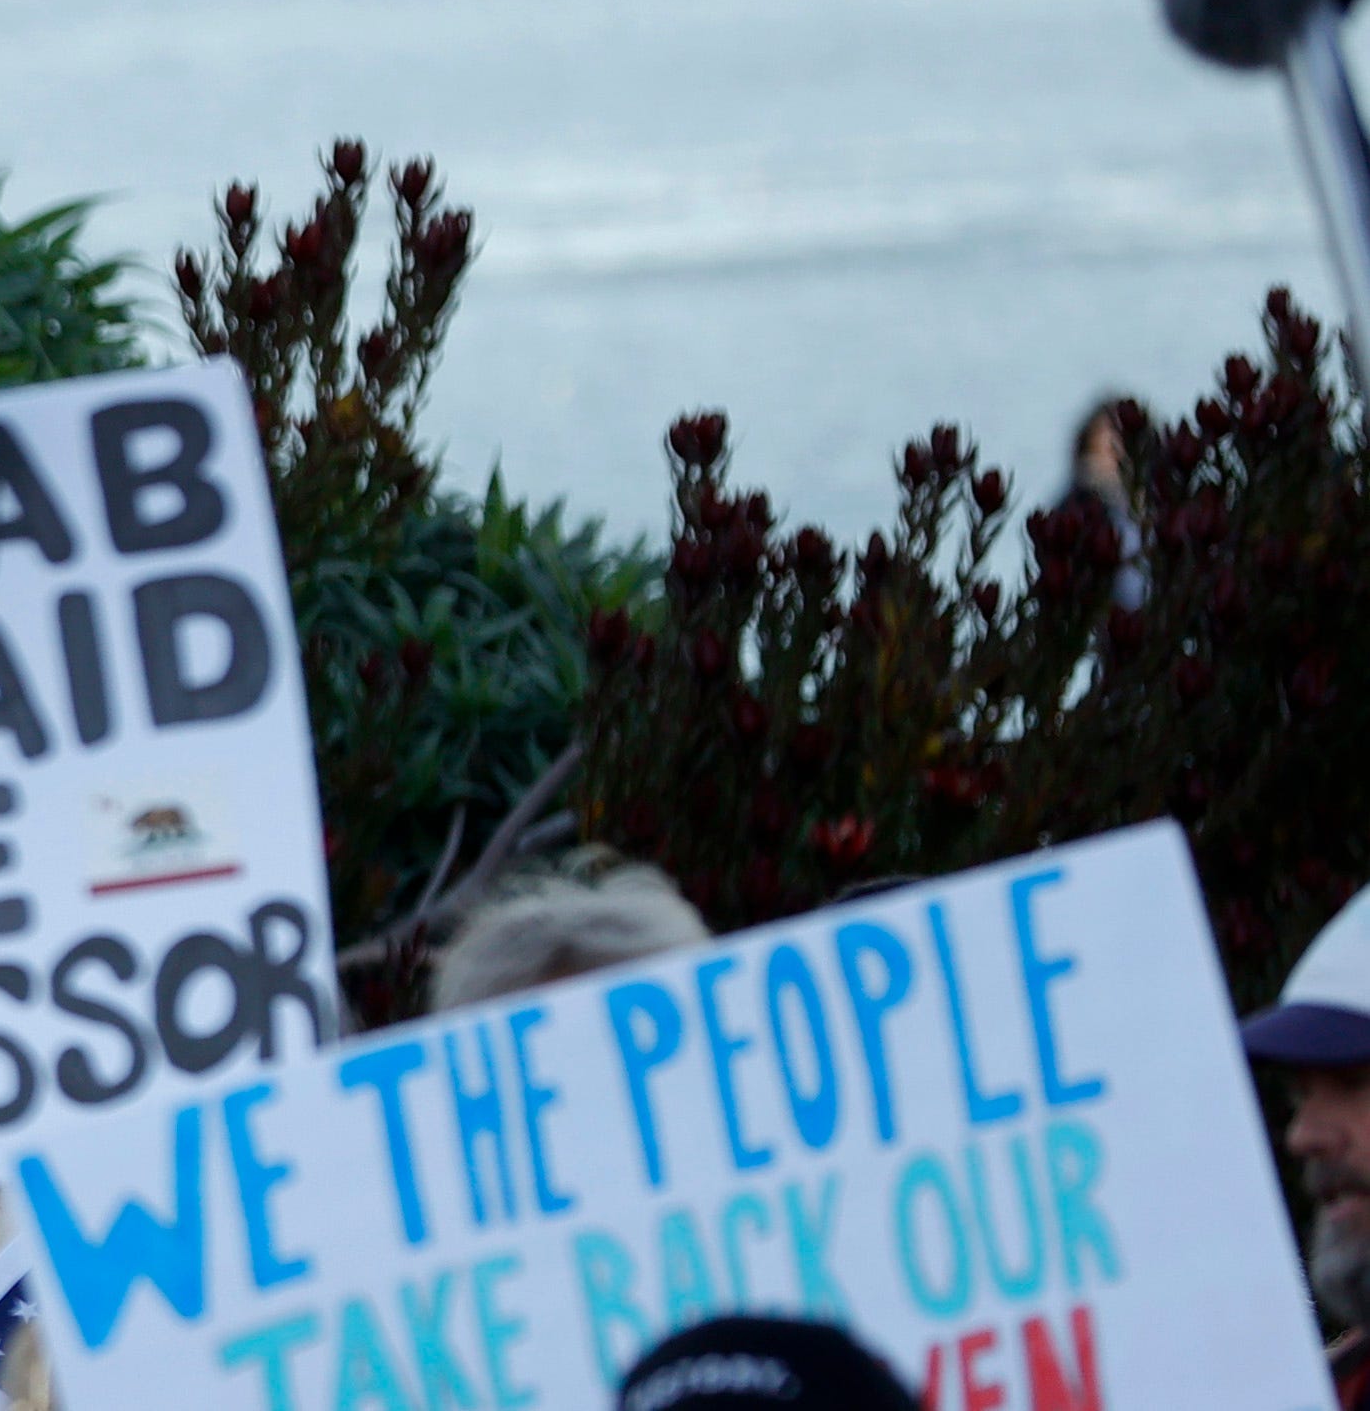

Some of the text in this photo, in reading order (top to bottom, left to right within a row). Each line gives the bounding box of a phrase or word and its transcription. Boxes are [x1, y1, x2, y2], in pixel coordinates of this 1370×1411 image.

[18, 866, 1108, 1352] WE THE PEOPLE
[217, 1251, 536, 1411] TAKE
[893, 1119, 1124, 1323] OUR
